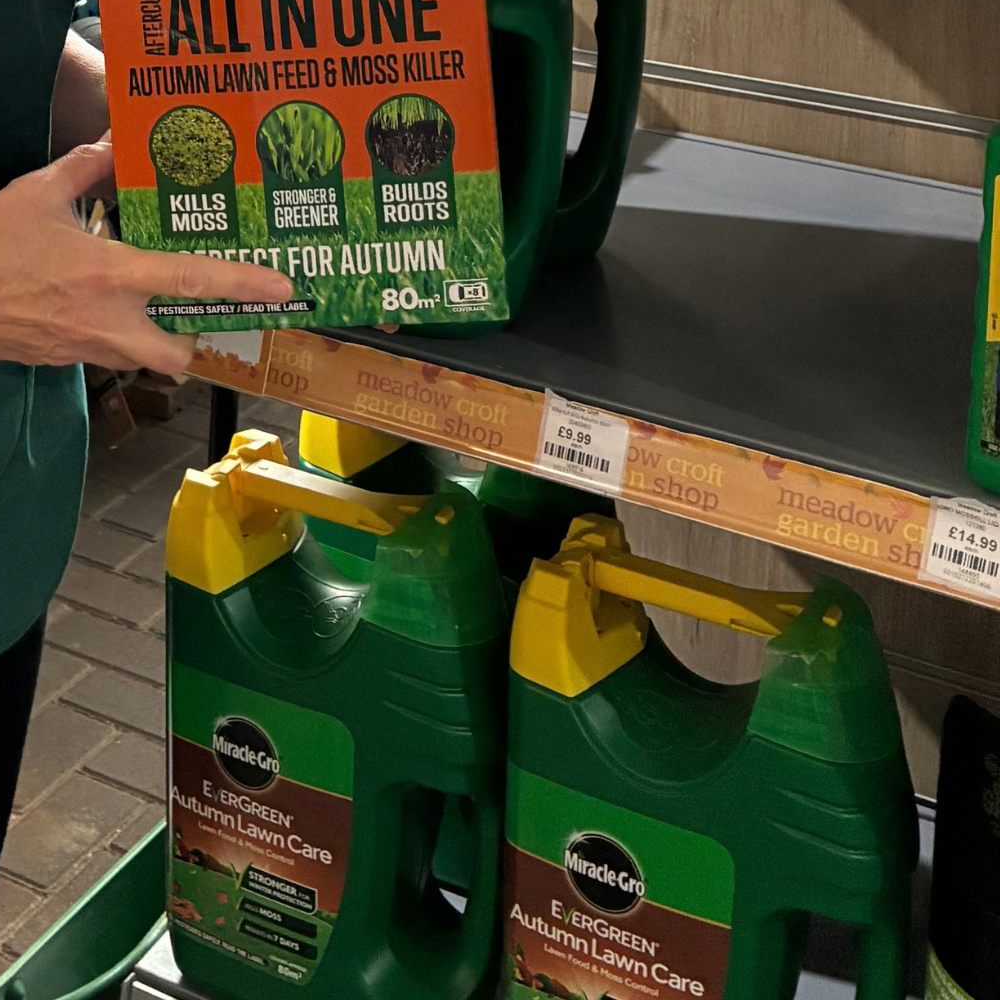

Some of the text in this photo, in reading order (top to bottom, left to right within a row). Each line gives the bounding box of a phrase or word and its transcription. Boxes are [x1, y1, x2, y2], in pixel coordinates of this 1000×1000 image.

[129, 49, 466, 98] AUTUMN LAWN FEED & MOSS KILLER
[169, 192, 227, 214] KILLS
[272, 187, 337, 206] STRONGER &
[381, 180, 449, 203] BUILDS
[171, 212, 228, 233] MOSS
[274, 204, 339, 230] GREENER
[383, 201, 451, 224] ROOTS
[288, 244, 334, 278] FOR
[340, 238, 446, 276] AUTUMN
[158, 301, 309, 315] PESTICIDES SAFELY READ THE LABEL
[355, 368, 453, 410] meadow
[456, 397, 509, 427] croft
[352, 389, 437, 428] garden
[443, 414, 505, 449] shop
[557, 426, 592, 446] £9.99
[948, 526, 998, 552] £14.99
[212, 733, 280, 774] Miracle-Gro
[171, 785, 333, 865] Autumn Lawn Care
[564, 849, 646, 898] Miracle-Gro
[510, 903, 705, 998] Autumn Lawn Care
